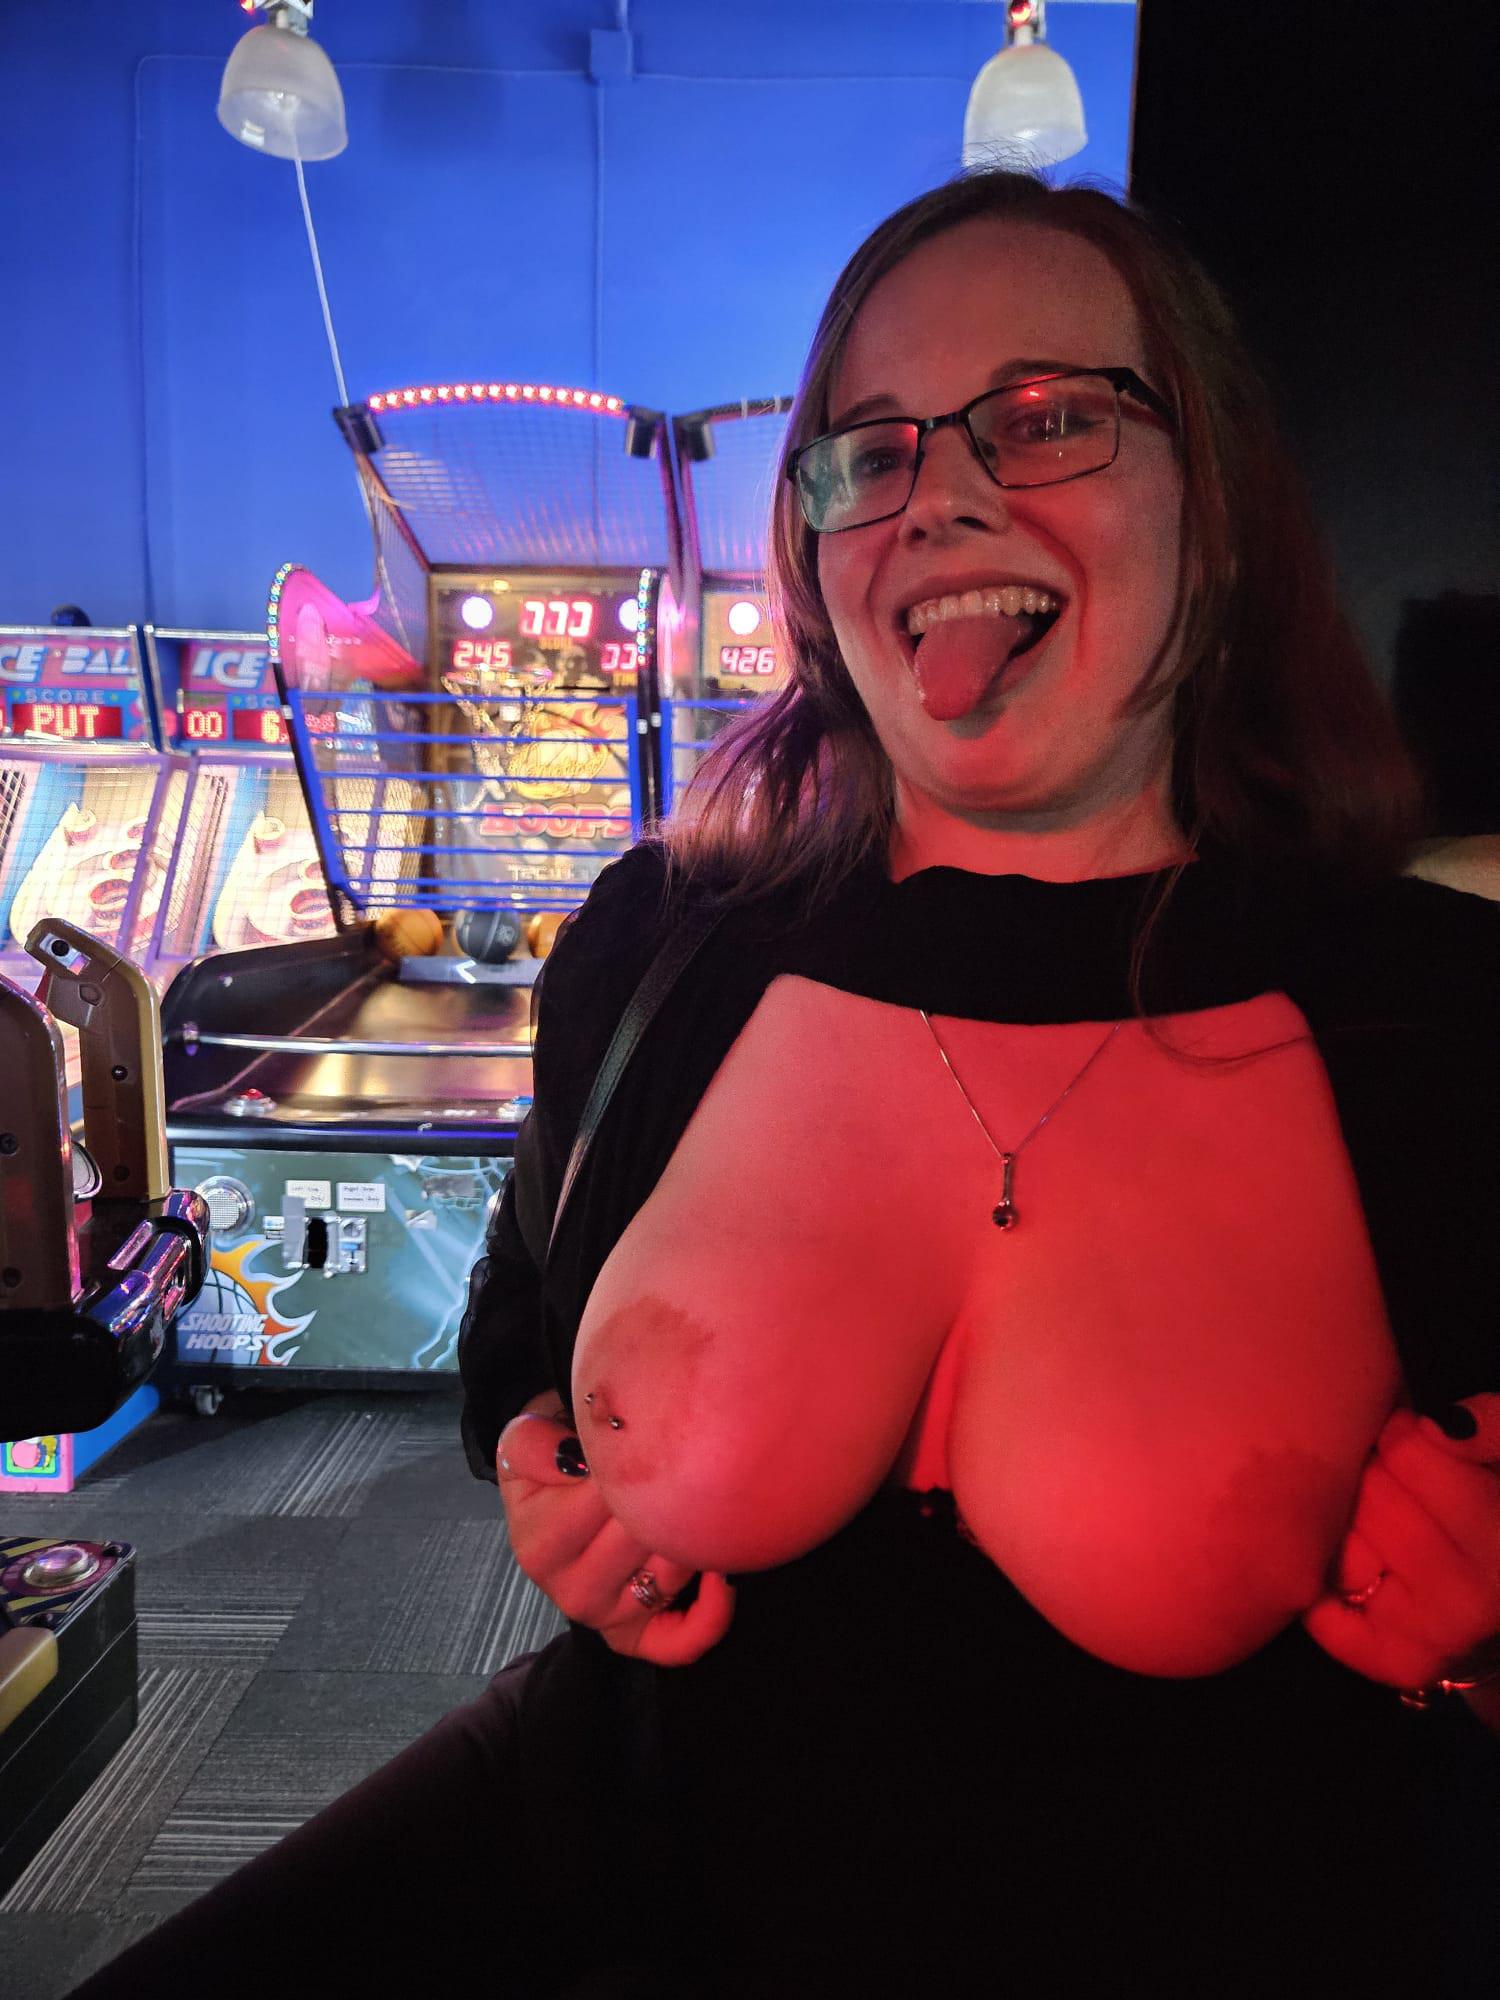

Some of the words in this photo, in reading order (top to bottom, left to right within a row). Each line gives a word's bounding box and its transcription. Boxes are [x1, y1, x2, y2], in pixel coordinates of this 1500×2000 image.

[192, 649, 268, 688] ICE
[453, 640, 512, 670] 245
[721, 647, 776, 674] 426
[25, 689, 105, 704] SCORE
[32, 704, 99, 738] PUT
[187, 710, 223, 738] 00
[177, 1313, 269, 1332] SHOOTING
[185, 1333, 272, 1351] HOOPS
